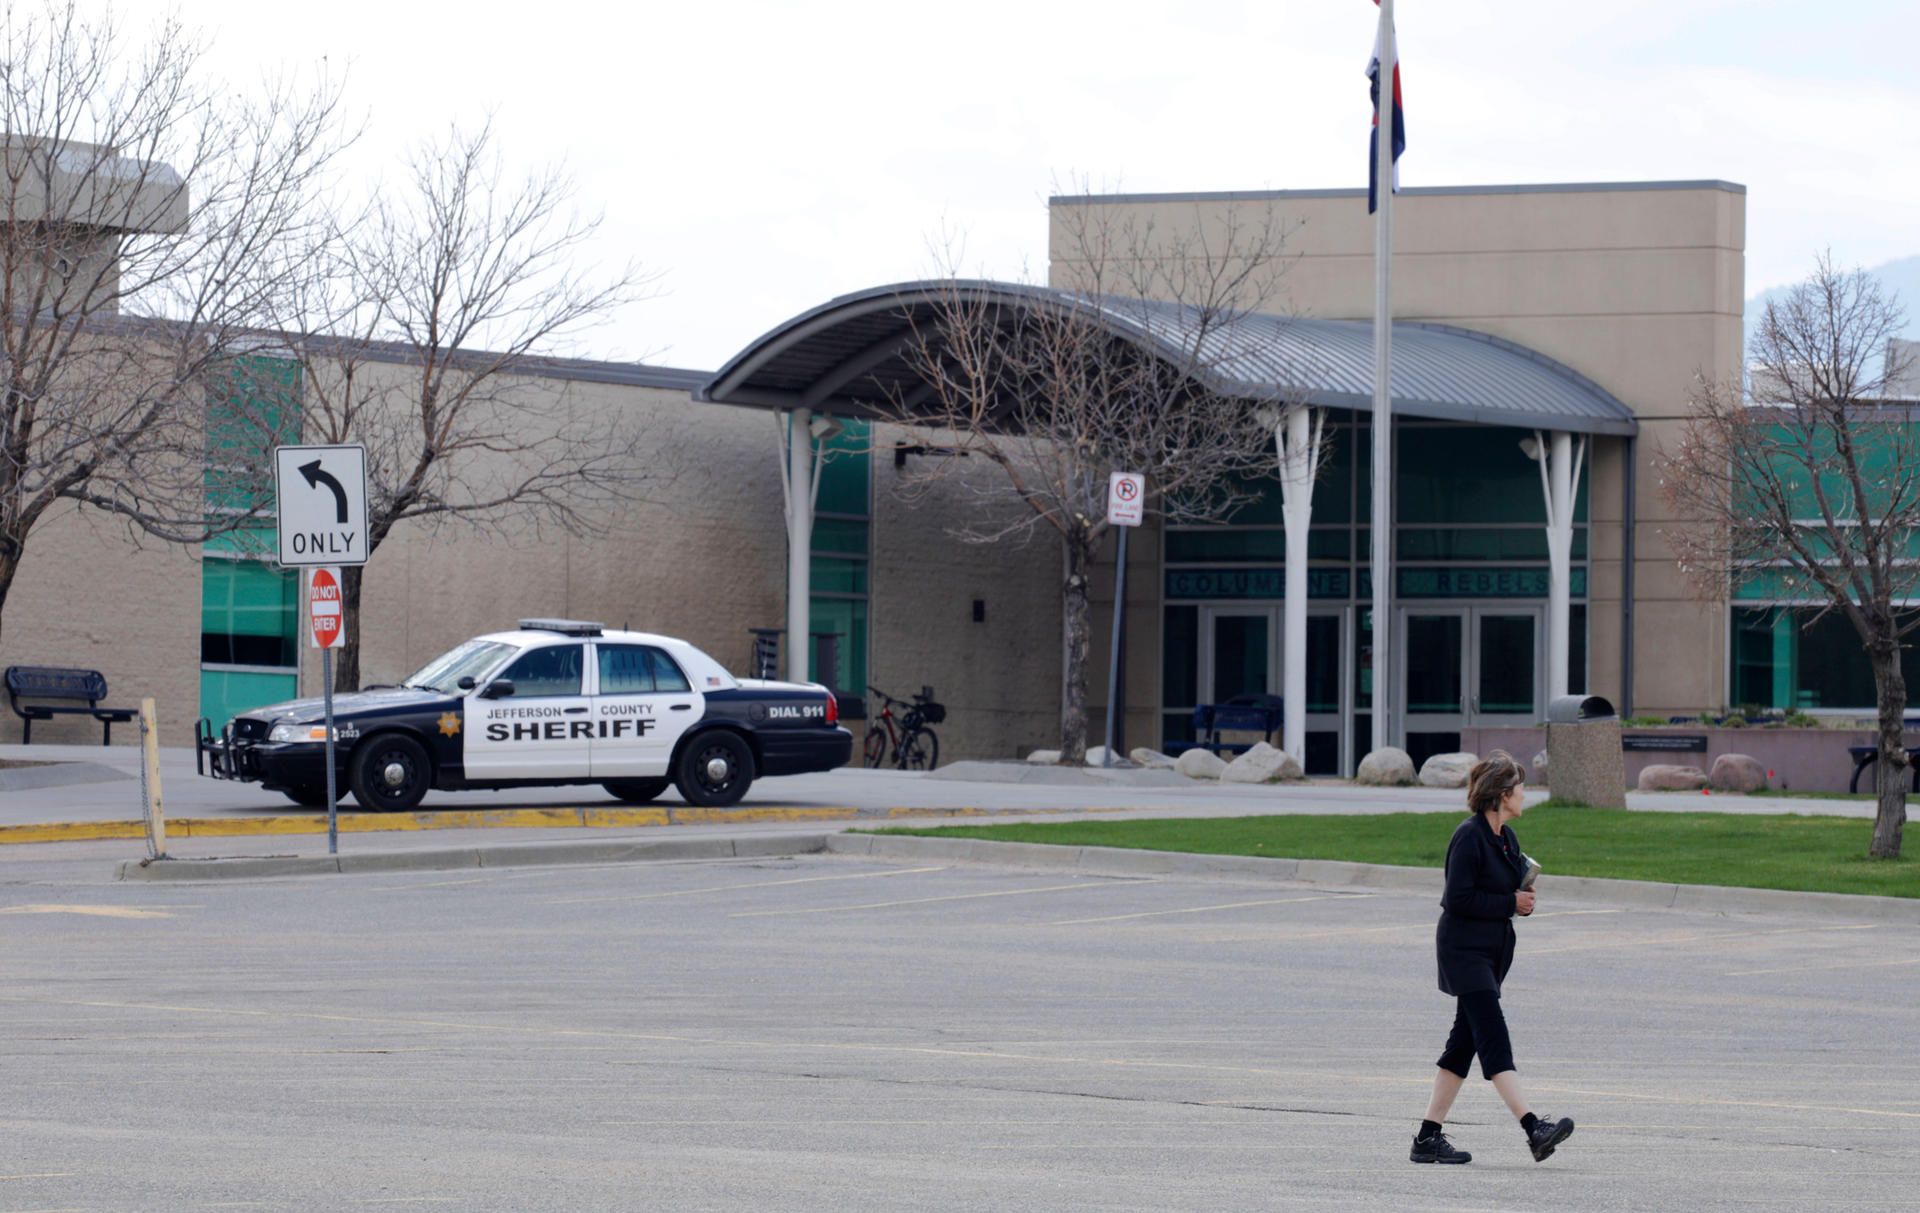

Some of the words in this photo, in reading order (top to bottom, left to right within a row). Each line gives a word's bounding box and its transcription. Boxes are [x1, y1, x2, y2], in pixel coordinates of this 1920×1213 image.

[292, 532, 355, 554] ONLY
[1175, 574, 1343, 593] COLUMNE
[1437, 573, 1548, 593] REBELS
[311, 586, 320, 600] DO
[320, 585, 337, 599] NOT
[314, 617, 336, 631] ENTER
[487, 706, 562, 719] JEFFERSON
[600, 704, 654, 715] COUNTY
[769, 706, 801, 718] DIAL
[802, 705, 825, 717] 911
[486, 719, 657, 742] SHERIFF
